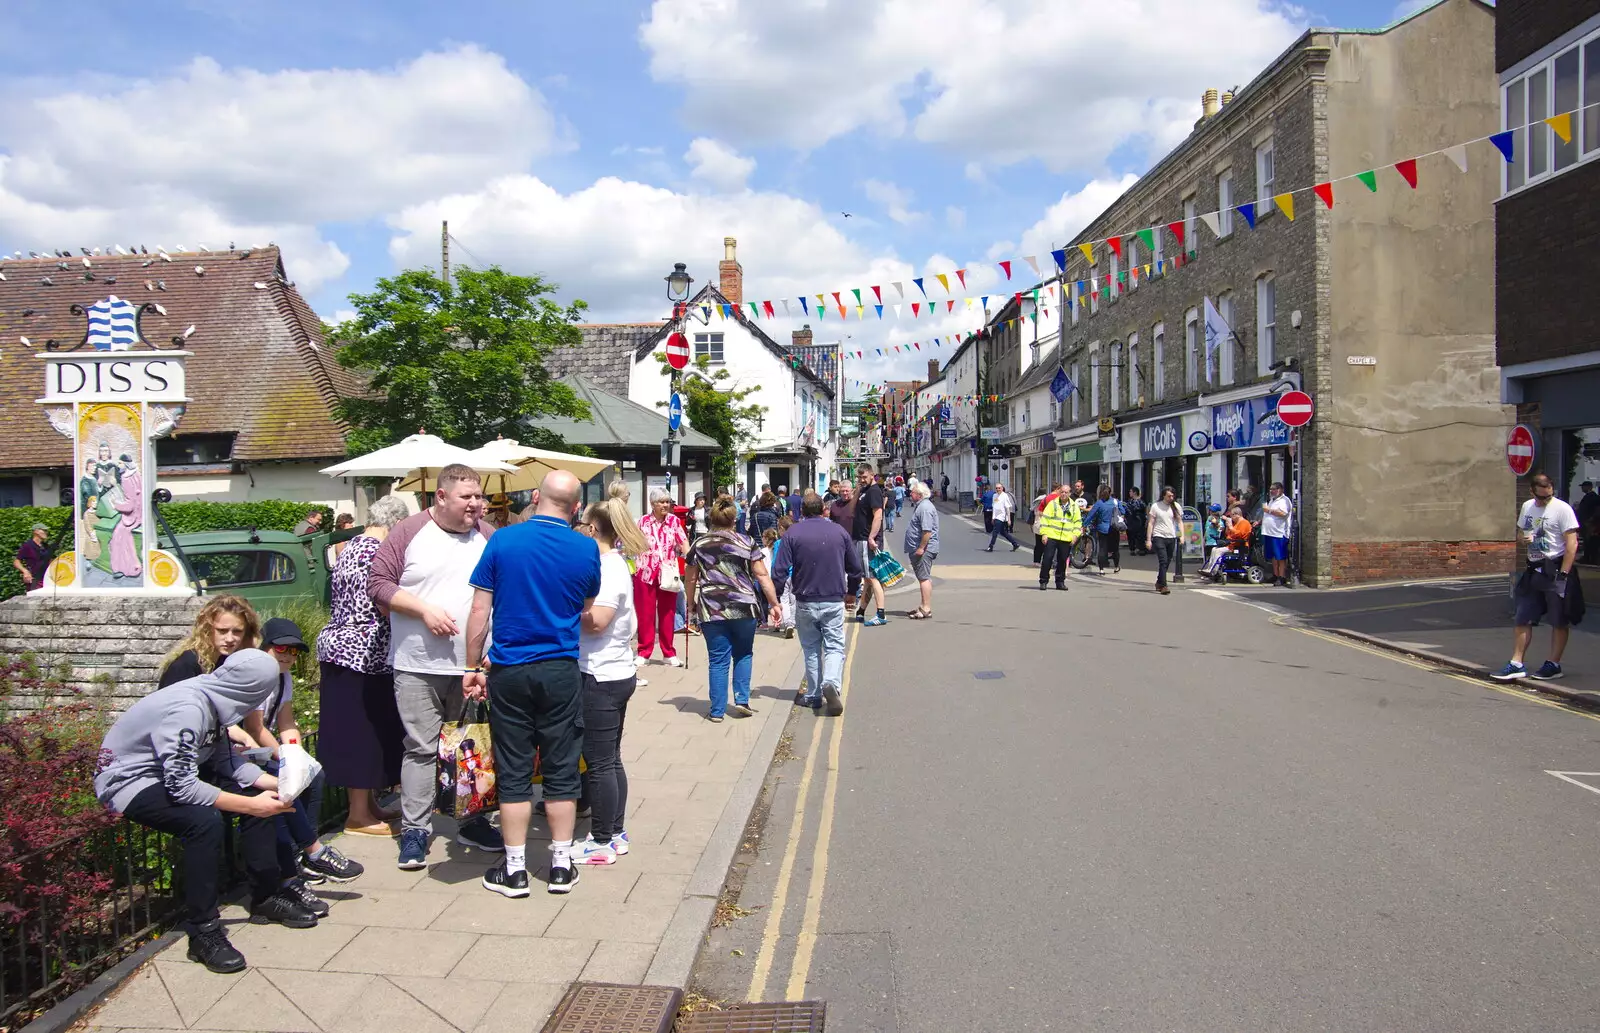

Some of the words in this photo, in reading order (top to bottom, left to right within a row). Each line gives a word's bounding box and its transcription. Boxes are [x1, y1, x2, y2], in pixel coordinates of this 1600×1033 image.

[56, 361, 168, 393] DISS
[1216, 404, 1244, 436] break
[1144, 423, 1176, 452] McColl's
